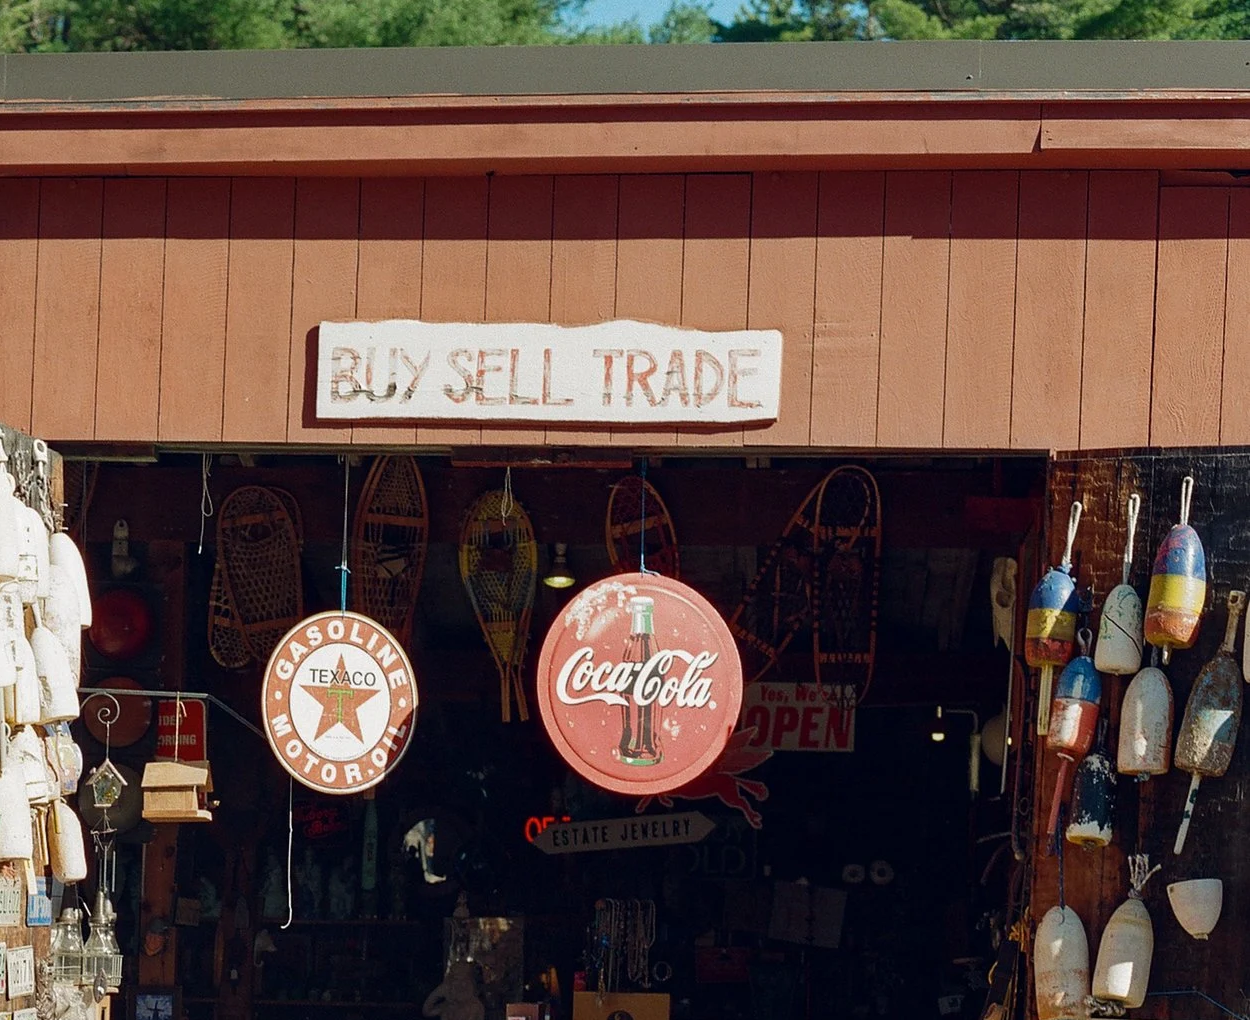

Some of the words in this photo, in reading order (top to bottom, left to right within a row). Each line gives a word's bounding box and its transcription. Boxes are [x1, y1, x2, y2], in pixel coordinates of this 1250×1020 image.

[330, 347, 431, 404] BUY
[443, 348, 574, 407] SELL
[594, 348, 762, 410] TRADE
[274, 619, 408, 691] GASOLINE
[309, 668, 377, 688] TEXACO
[556, 646, 719, 710] Coca-Cola
[745, 704, 852, 749] OPEN
[552, 825, 609, 847] ESTATE
[620, 818, 692, 842] JEWELRY
